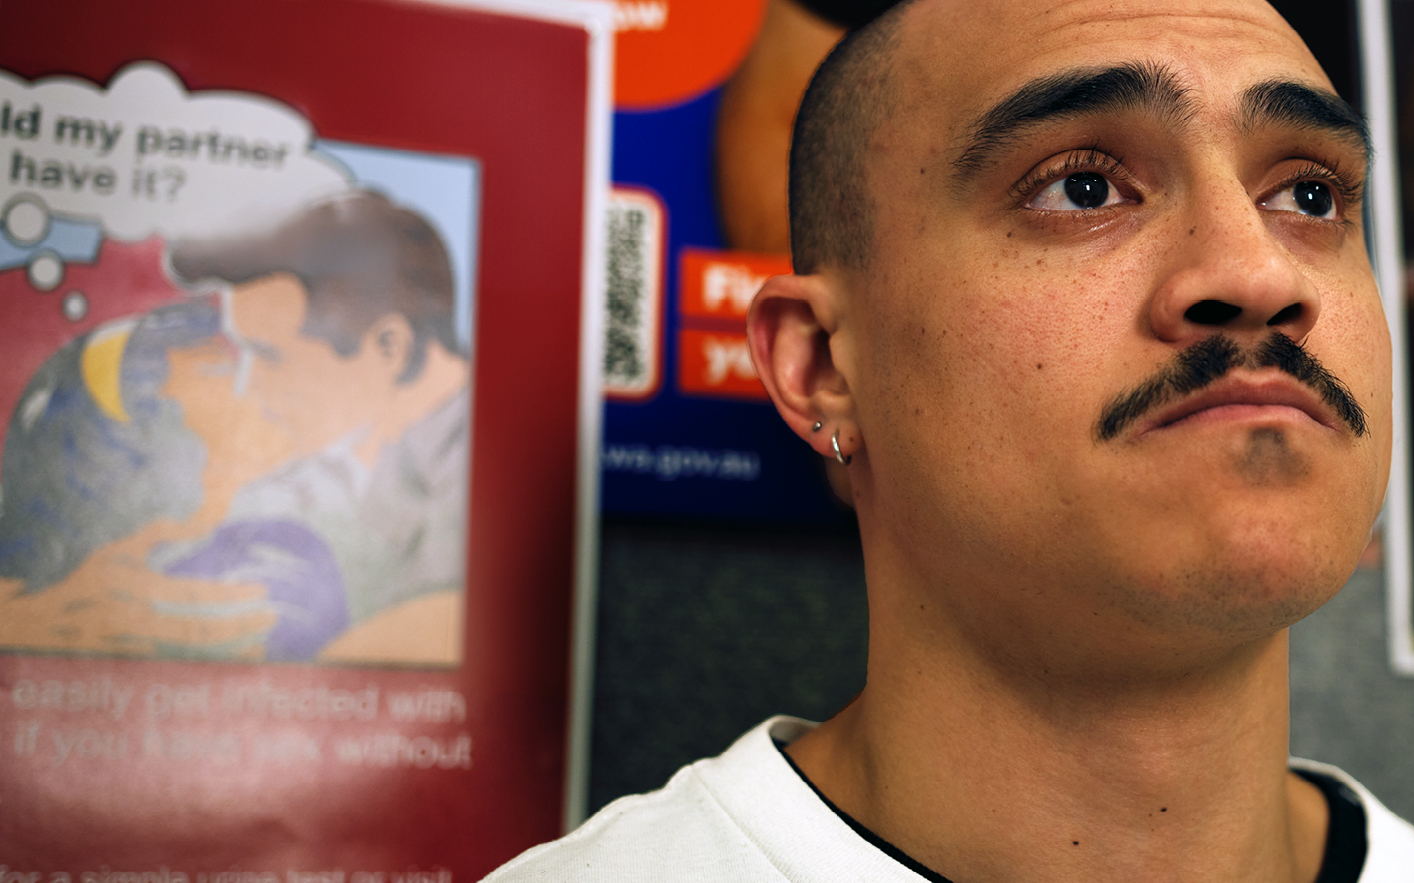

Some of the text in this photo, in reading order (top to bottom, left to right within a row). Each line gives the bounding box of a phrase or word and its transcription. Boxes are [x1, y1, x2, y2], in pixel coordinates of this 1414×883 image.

[54, 113, 123, 156] my
[134, 123, 290, 170] partner
[9, 148, 188, 203] have it?
[12, 677, 134, 722] easily
[220, 677, 380, 722] infected
[385, 685, 467, 723] with
[14, 718, 42, 757] if
[50, 728, 129, 770] you
[333, 731, 473, 771] without
